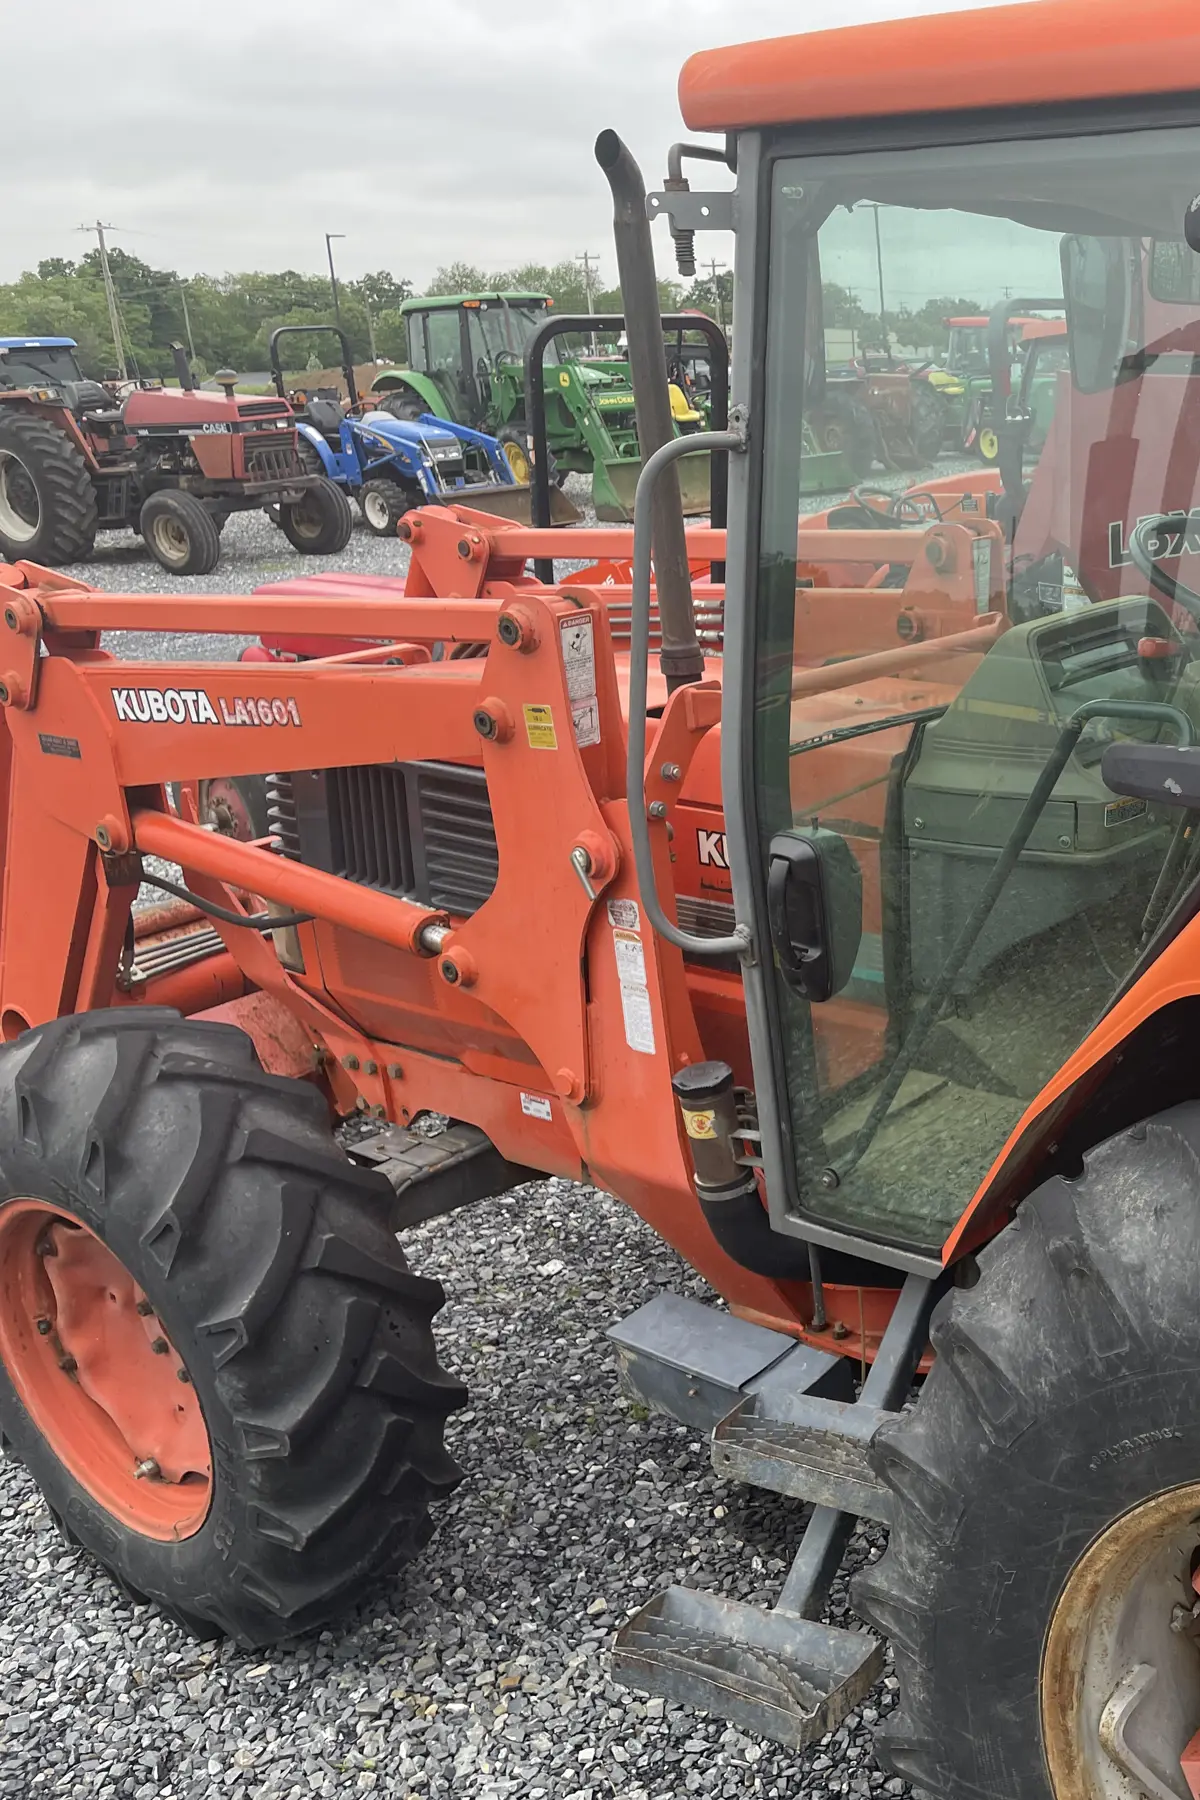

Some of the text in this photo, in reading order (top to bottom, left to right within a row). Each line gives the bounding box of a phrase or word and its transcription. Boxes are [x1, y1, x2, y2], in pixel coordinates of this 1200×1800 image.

[202, 423, 228, 434] CASE
[111, 688, 302, 727] KUBOTA LA1601
